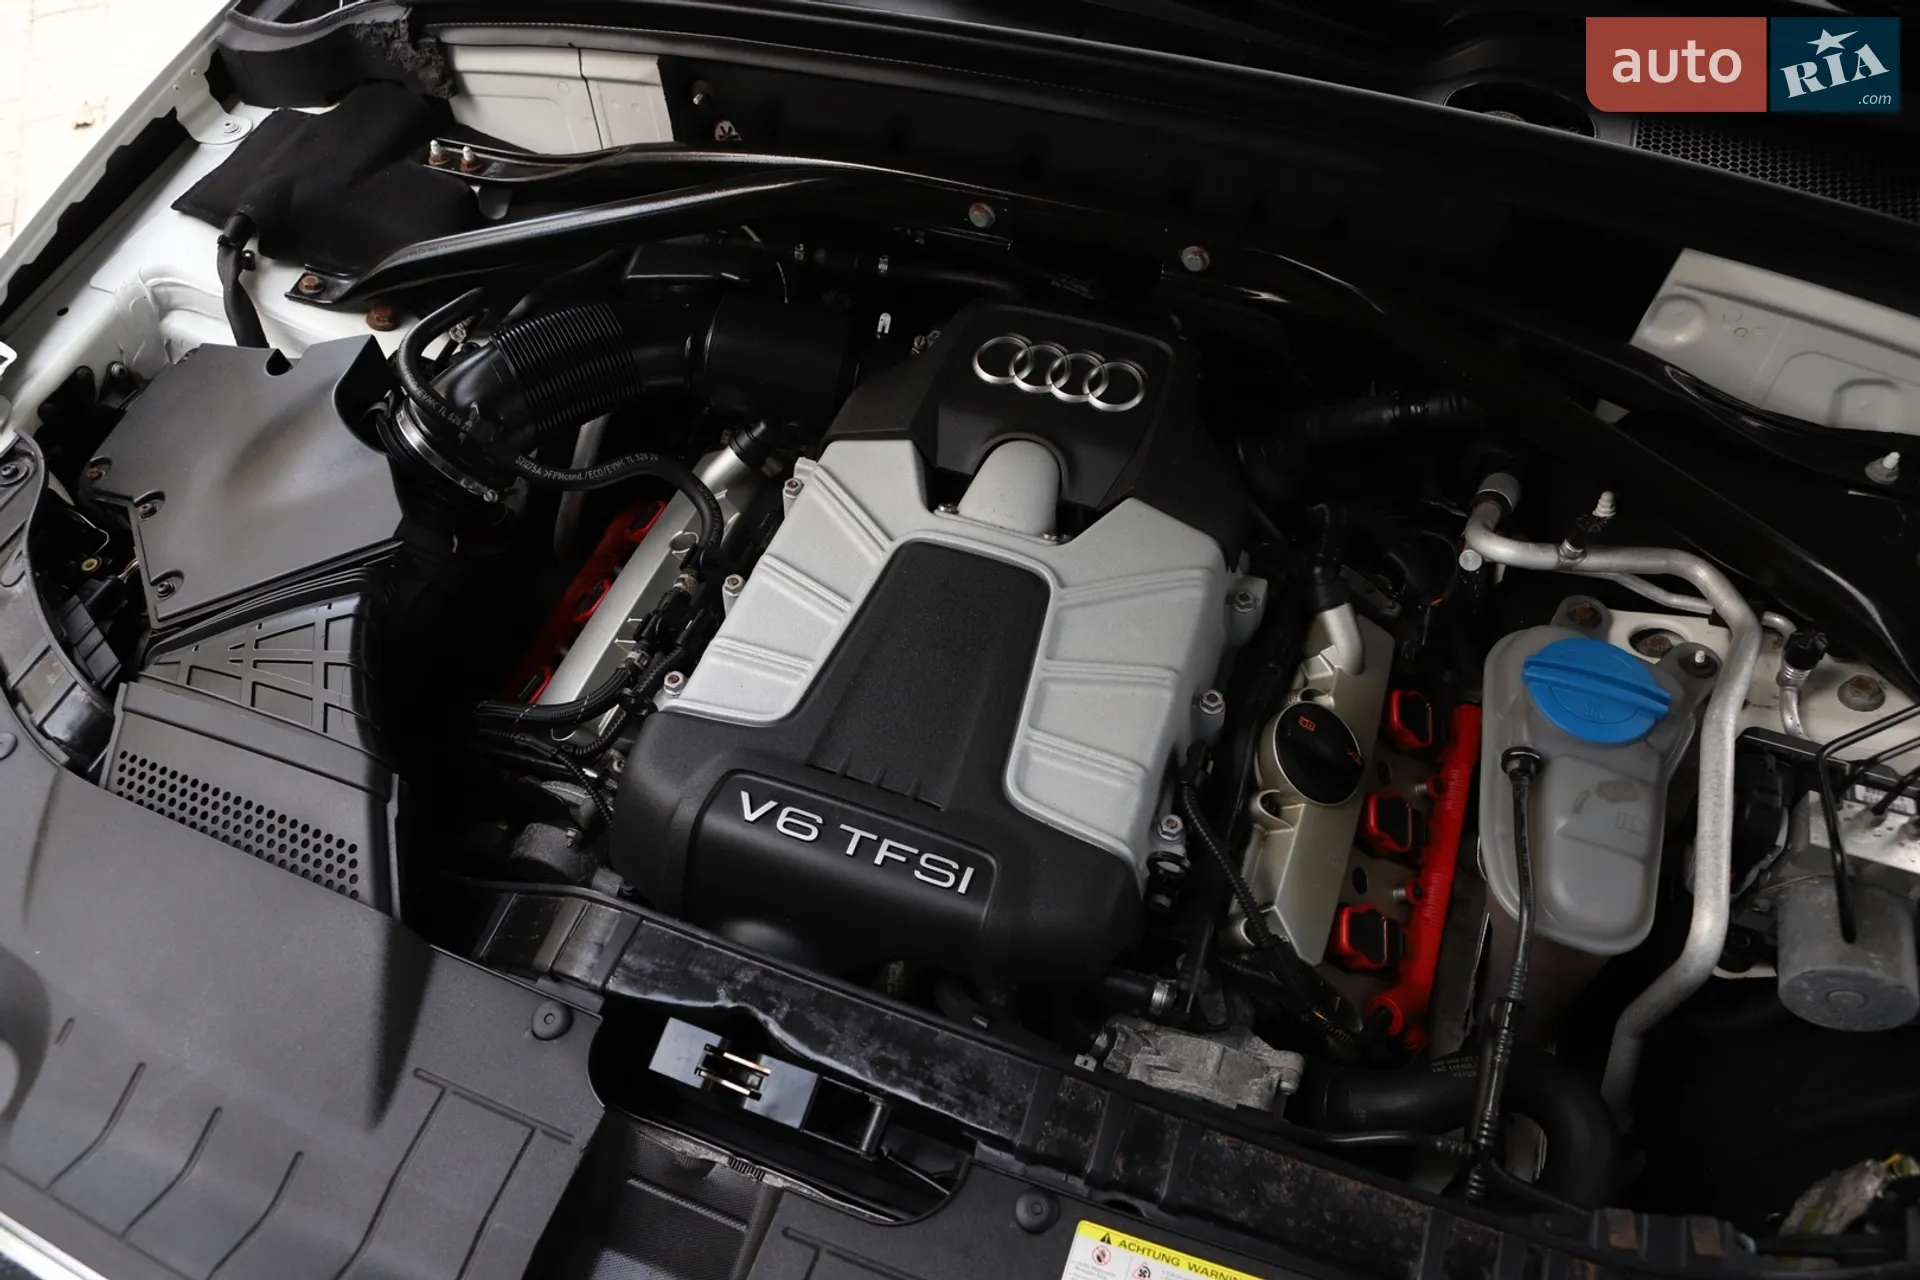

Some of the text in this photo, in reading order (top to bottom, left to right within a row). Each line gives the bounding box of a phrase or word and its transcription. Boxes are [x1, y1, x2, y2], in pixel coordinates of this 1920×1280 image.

[740, 790, 976, 895] V6 TFSI
[1117, 1239, 1181, 1268] ACHTUNG
